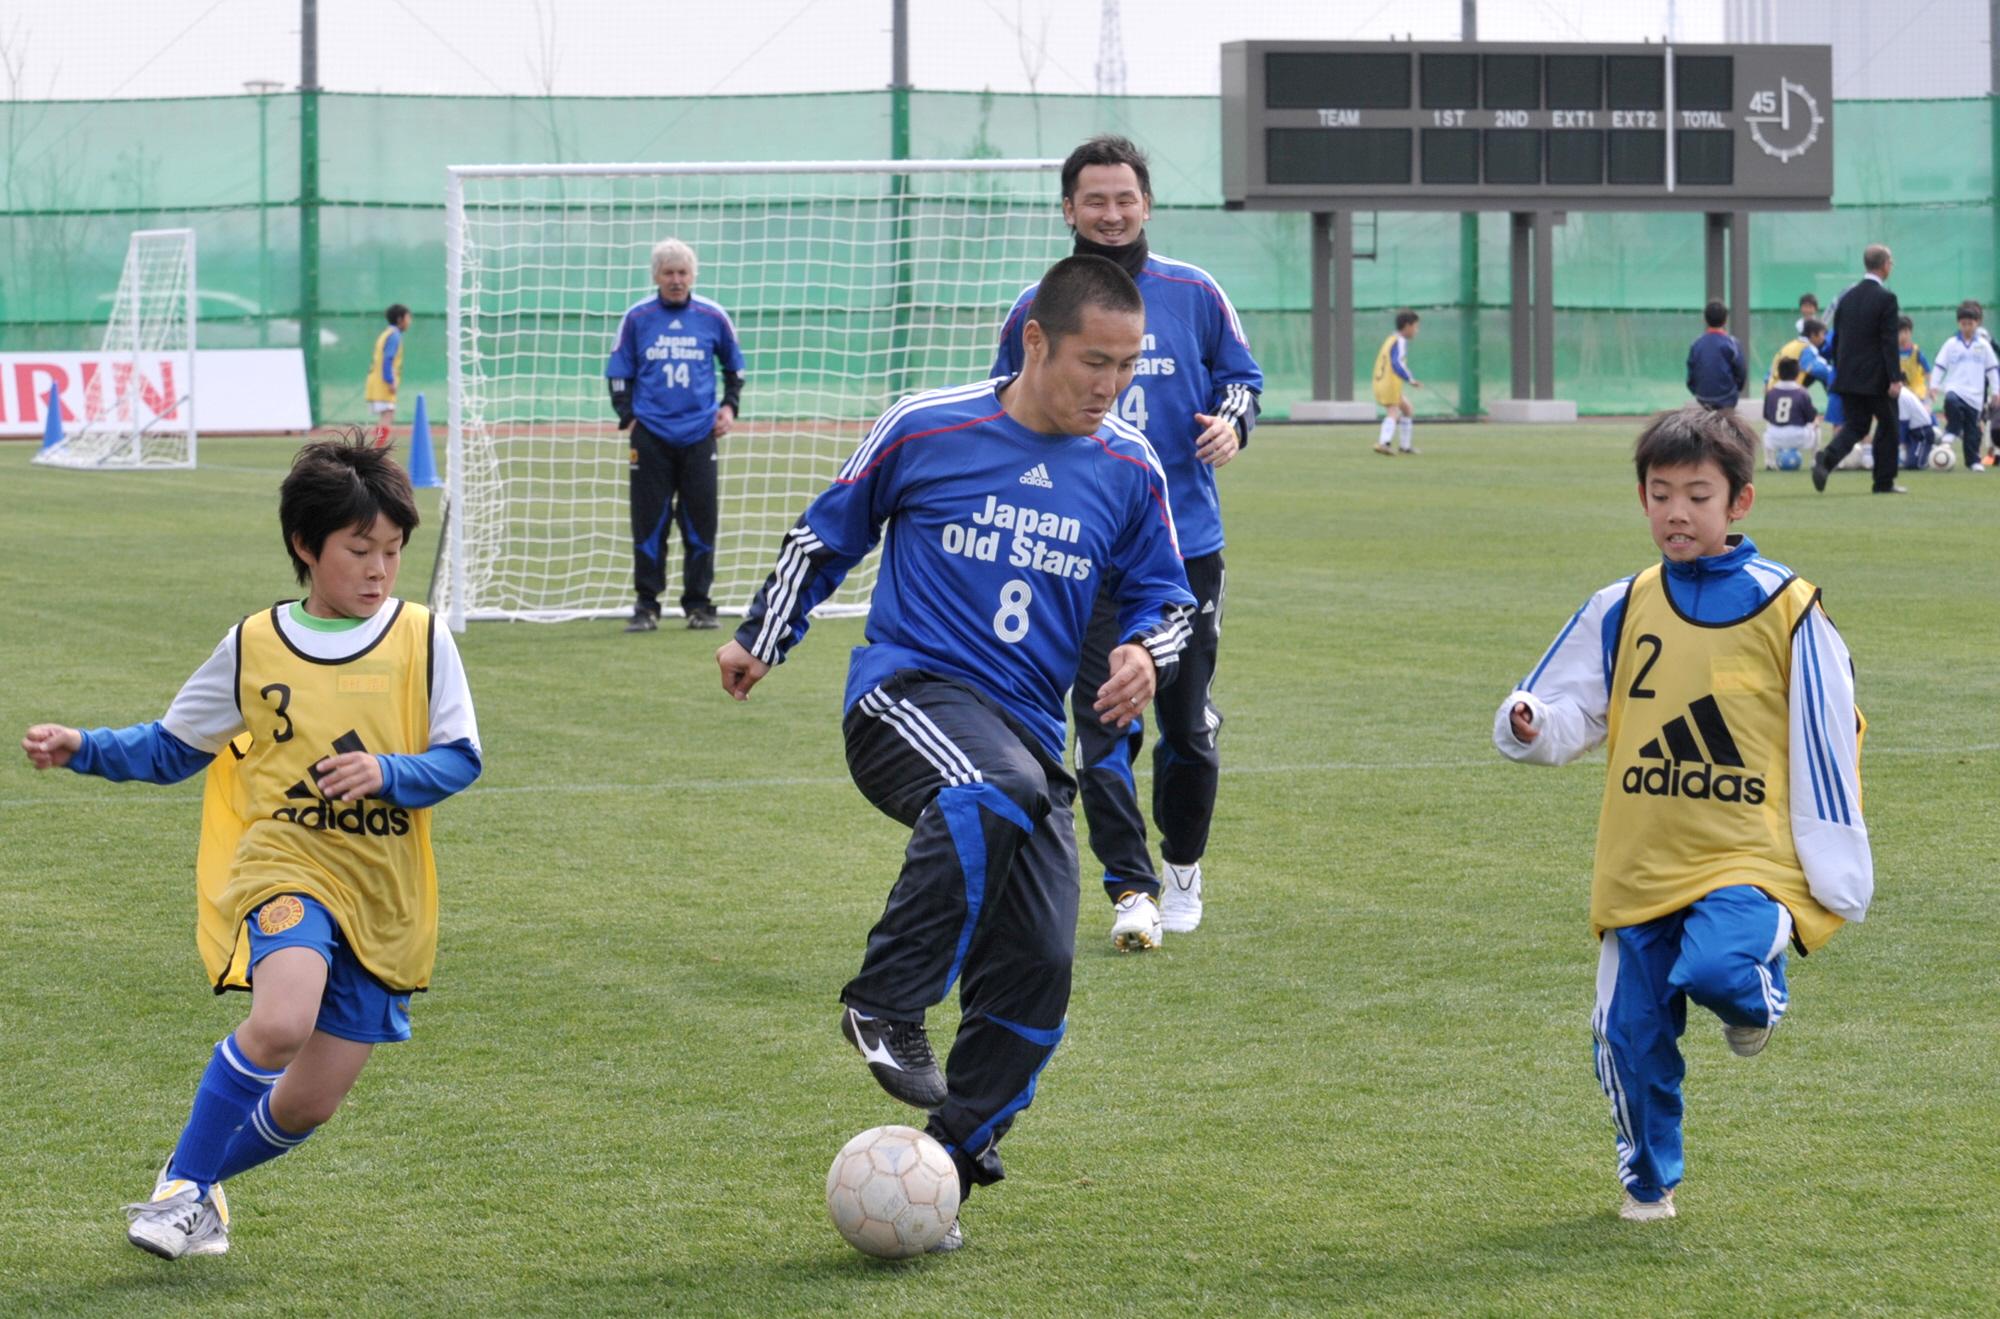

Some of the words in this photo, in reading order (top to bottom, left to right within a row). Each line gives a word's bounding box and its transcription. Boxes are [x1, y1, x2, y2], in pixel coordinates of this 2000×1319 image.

[1318, 109, 1360, 127] TEAM
[1433, 110, 1466, 127] 1ST
[1495, 110, 1529, 127] 2ND
[1552, 110, 1595, 128] EXT1
[1611, 110, 1657, 128] EXT2
[1682, 110, 1726, 128] TOTAL
[1749, 91, 1776, 113] 45
[662, 362, 690, 388] 14
[1132, 357, 1176, 375] ars
[0, 361, 178, 423] RIN
[1775, 397, 1792, 423] 8
[1019, 475, 1053, 489] adidas
[972, 495, 1081, 544] Japan
[942, 523, 1000, 562] Old
[1008, 536, 1092, 581] Stars
[993, 579, 1032, 643] 8
[1629, 634, 1662, 699] 2
[260, 683, 294, 743] 3
[1622, 758, 1766, 805] adidas
[271, 798, 410, 836] adidas
